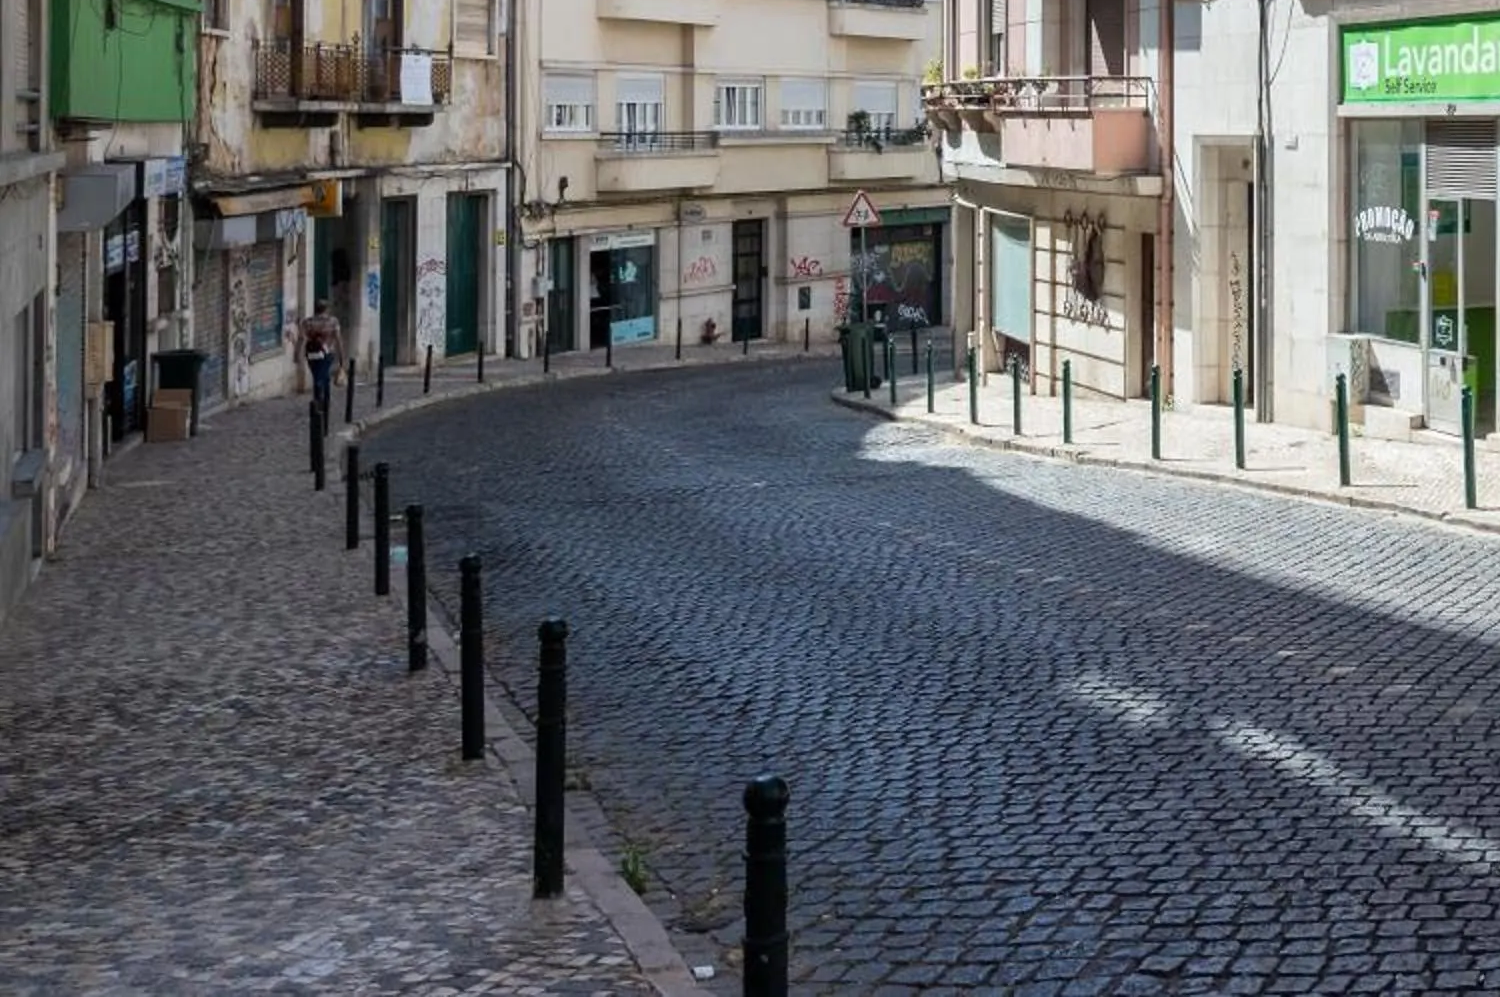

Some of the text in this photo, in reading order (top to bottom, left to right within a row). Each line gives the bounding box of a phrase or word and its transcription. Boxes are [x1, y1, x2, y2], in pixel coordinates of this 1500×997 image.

[1384, 78, 1437, 94] Self Service
[1355, 206, 1415, 241] PROMOÇÃO
